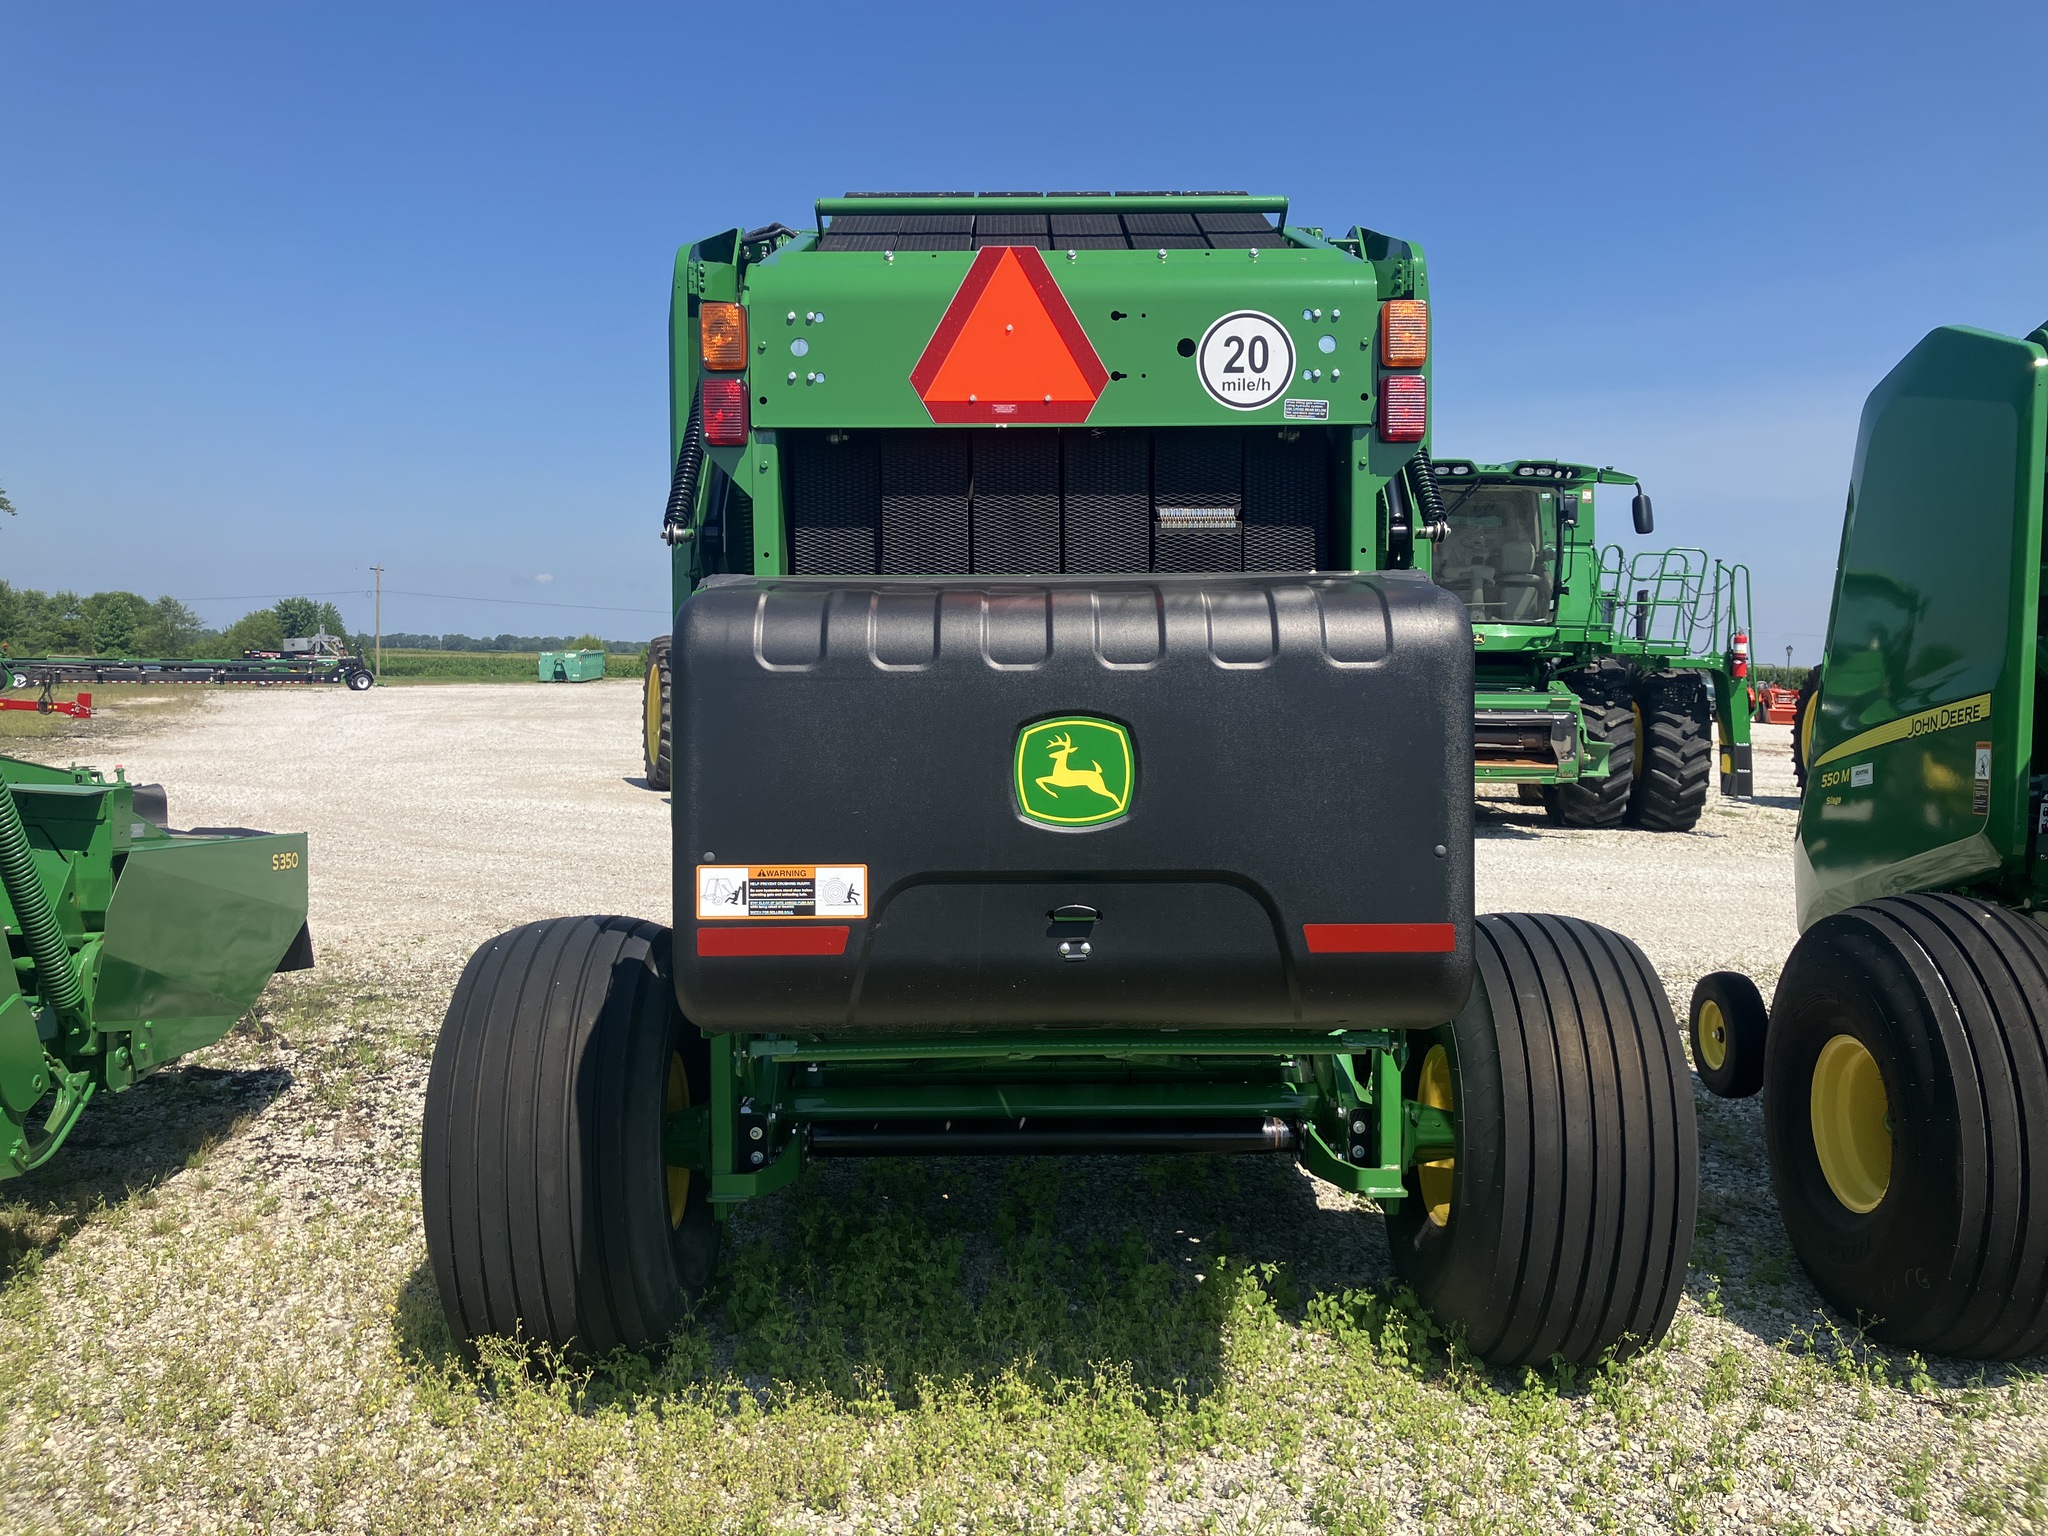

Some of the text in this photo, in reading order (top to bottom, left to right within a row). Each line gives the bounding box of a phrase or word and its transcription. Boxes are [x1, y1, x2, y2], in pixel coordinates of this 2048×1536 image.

[1223, 335, 1269, 374] 20
[1222, 377, 1271, 391] mile/h
[1908, 704, 1981, 736] JOHN DEERE
[1821, 771, 1840, 788] 550
[1841, 768, 1850, 783] M
[272, 852, 299, 871] S350
[766, 869, 807, 877] WARNING
